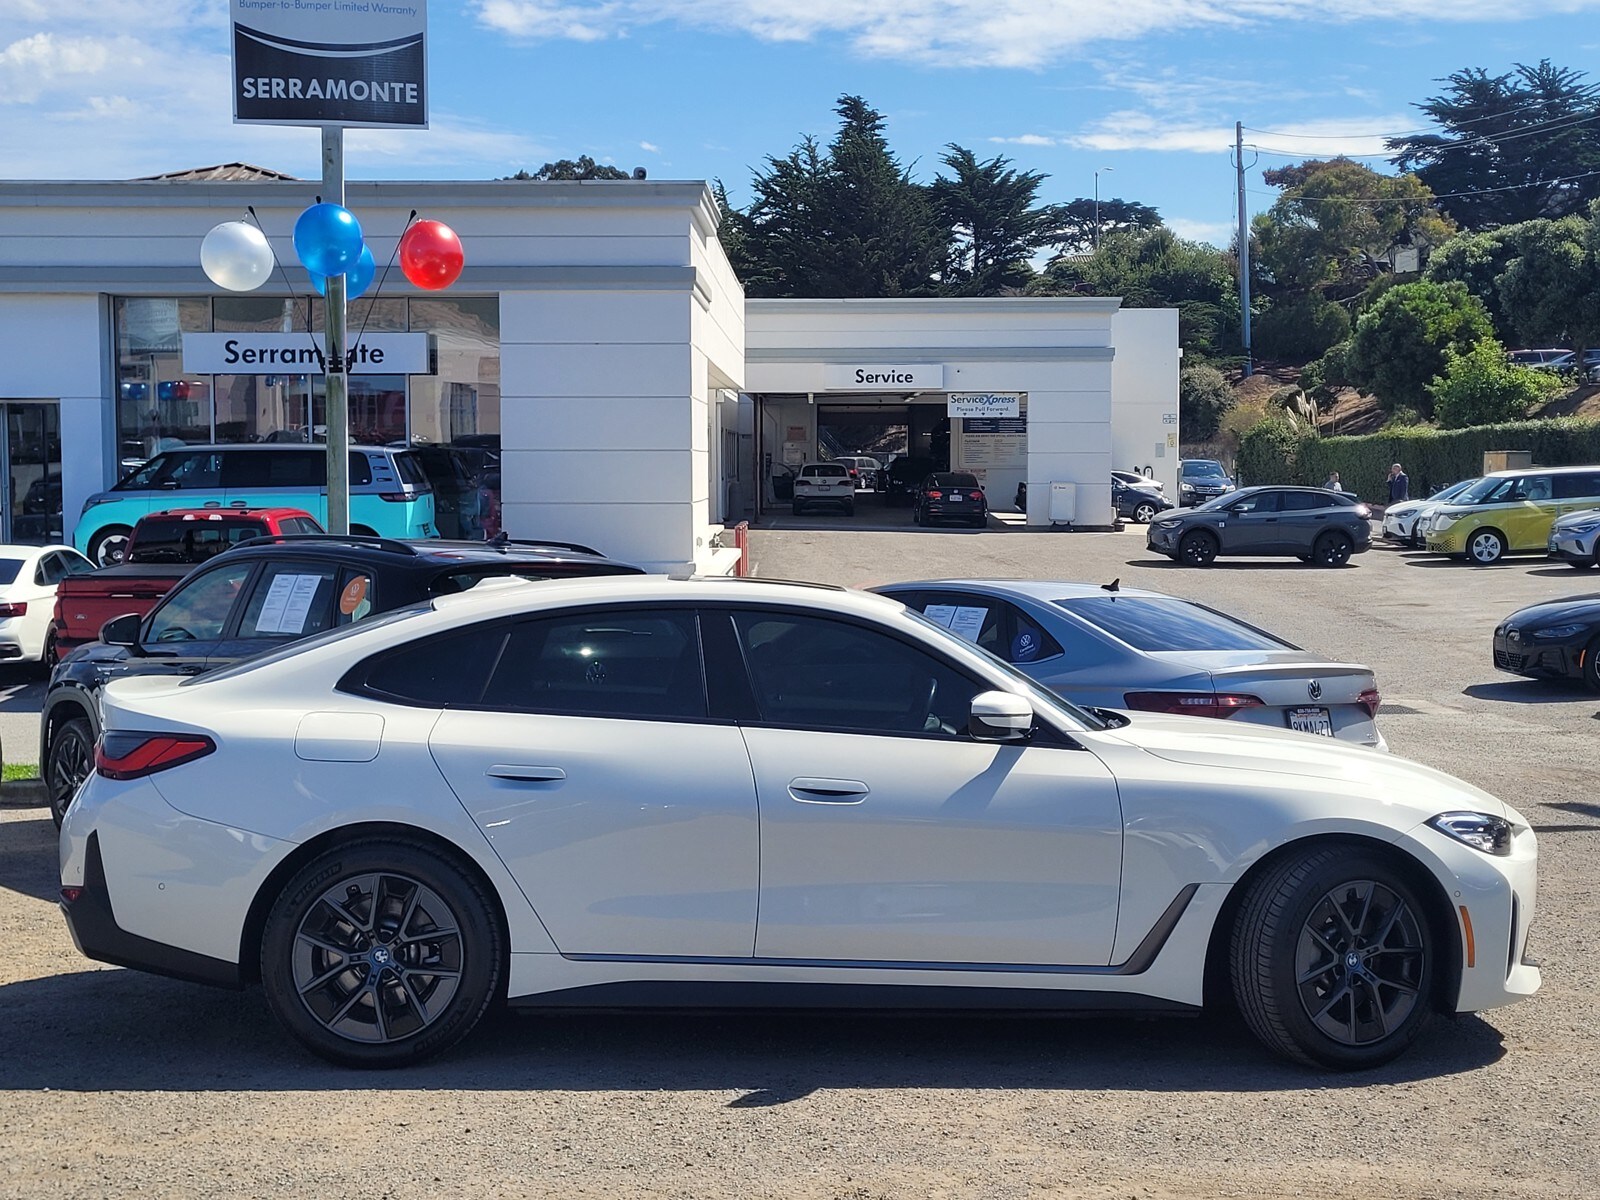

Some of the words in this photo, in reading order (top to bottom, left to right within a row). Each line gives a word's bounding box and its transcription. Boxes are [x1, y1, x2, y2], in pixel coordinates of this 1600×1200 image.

[239, 0, 332, 12] Bumper-to-Bumper
[334, 1, 369, 12] Limited
[371, 2, 417, 17] Warranty
[242, 77, 418, 104] SERRAMONTE
[855, 368, 914, 384] Service
[950, 394, 1017, 405] ServiceXpress
